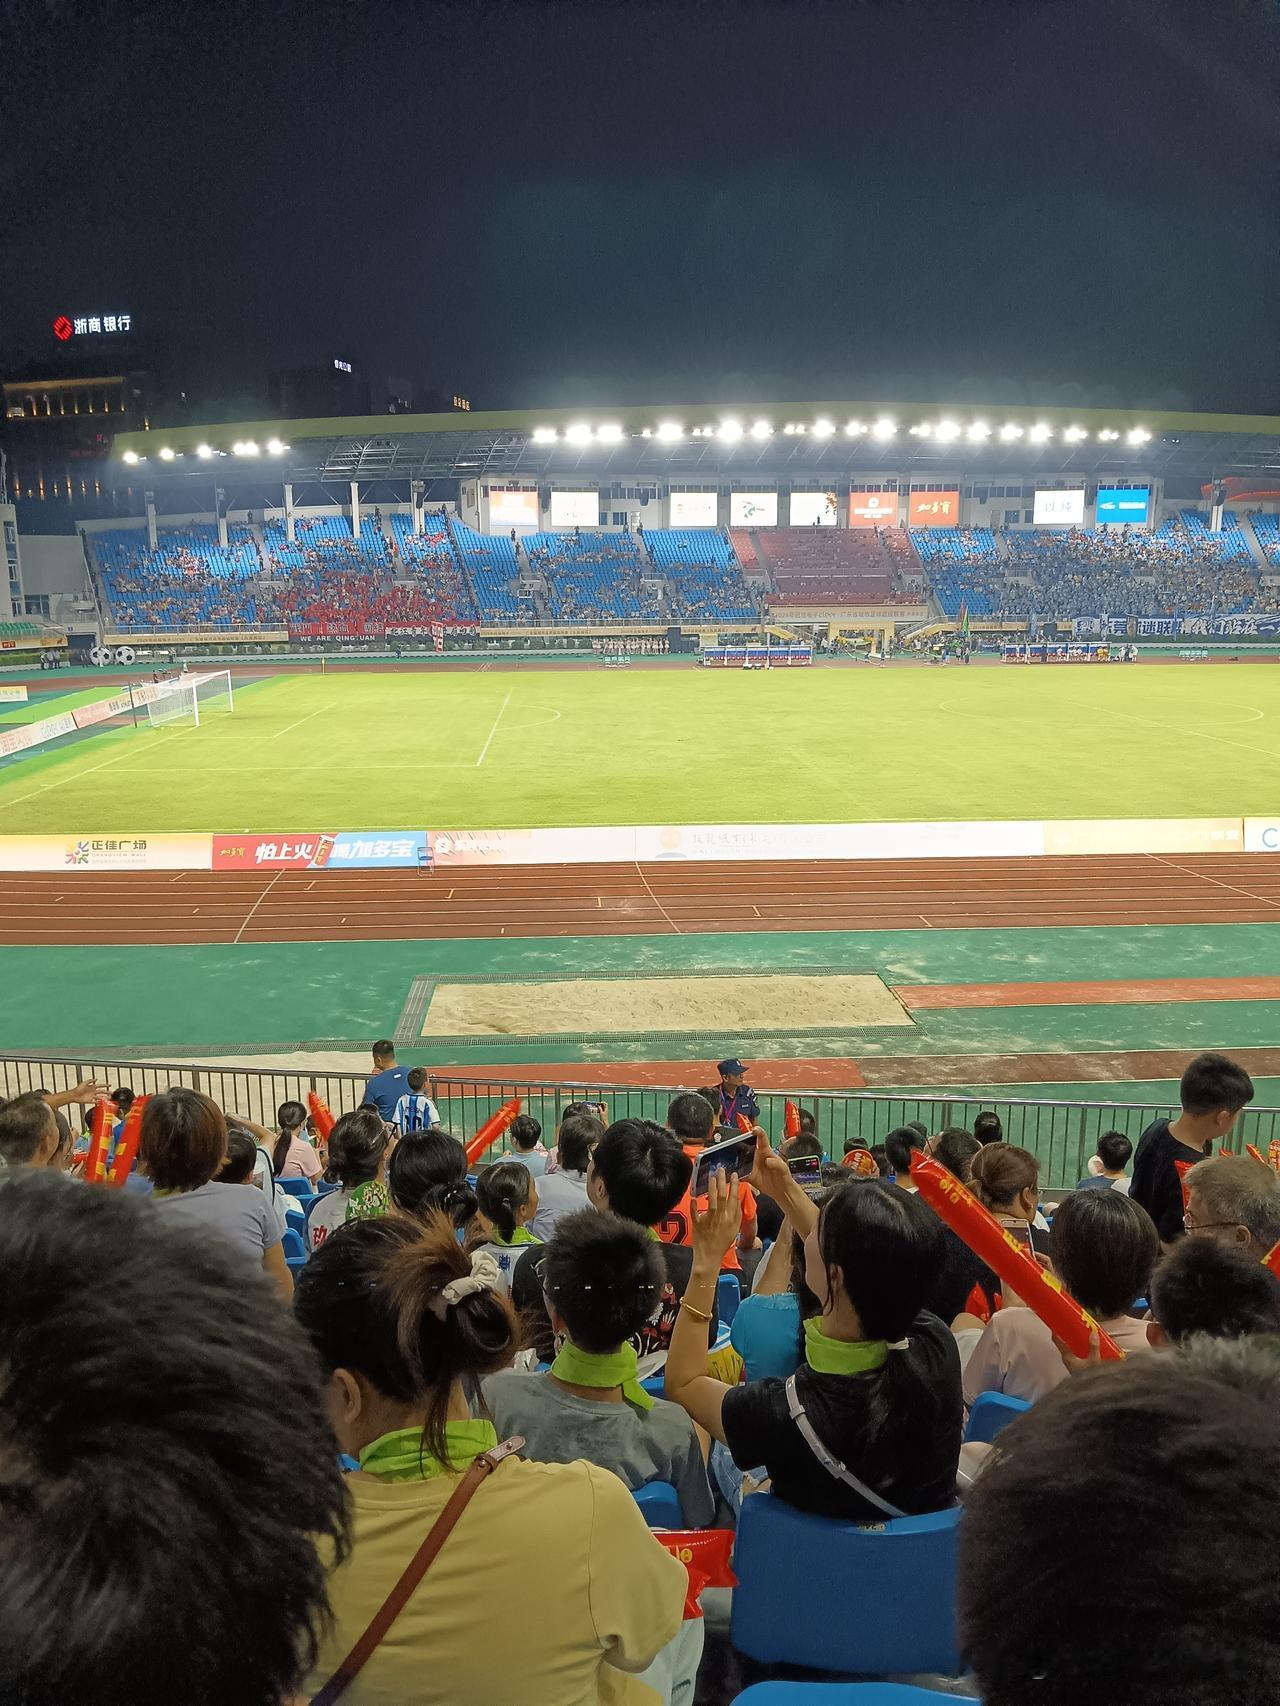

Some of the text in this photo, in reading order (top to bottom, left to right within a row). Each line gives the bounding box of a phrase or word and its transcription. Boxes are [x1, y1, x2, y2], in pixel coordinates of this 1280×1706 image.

[74, 315, 131, 335] 浙商银行
[91, 839, 147, 851] 正佳广场
[254, 841, 314, 864] 怕上火
